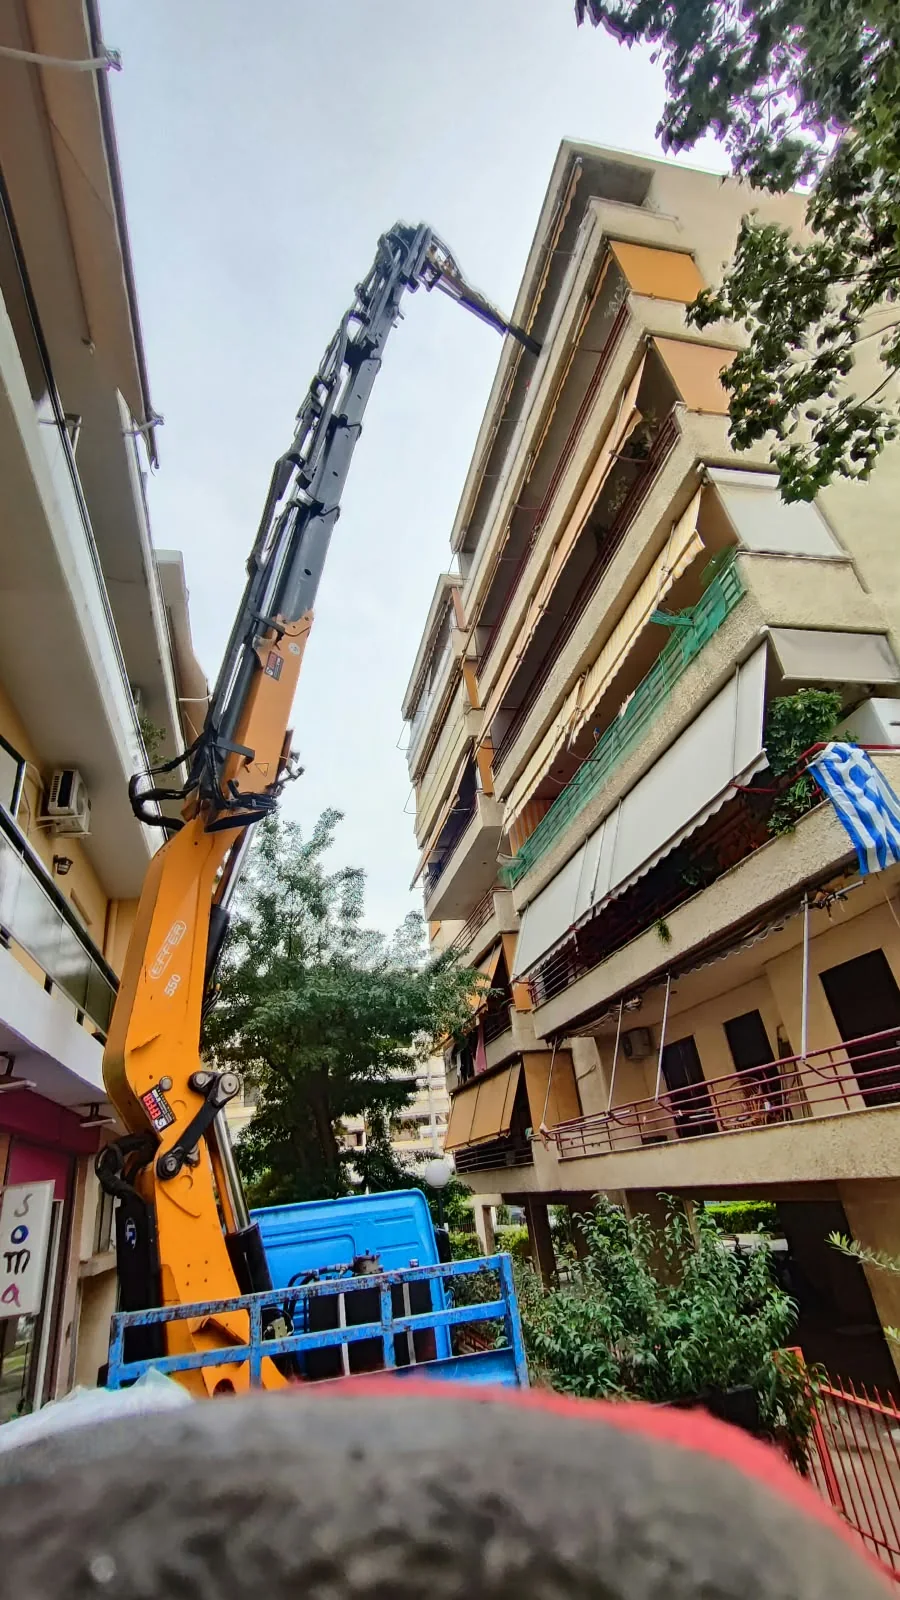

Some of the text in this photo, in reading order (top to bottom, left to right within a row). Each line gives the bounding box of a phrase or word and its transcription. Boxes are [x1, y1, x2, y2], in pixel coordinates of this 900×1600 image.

[150, 921, 186, 977] EFFER
[164, 974, 181, 997] 550
[143, 1092, 162, 1120] EFFER
